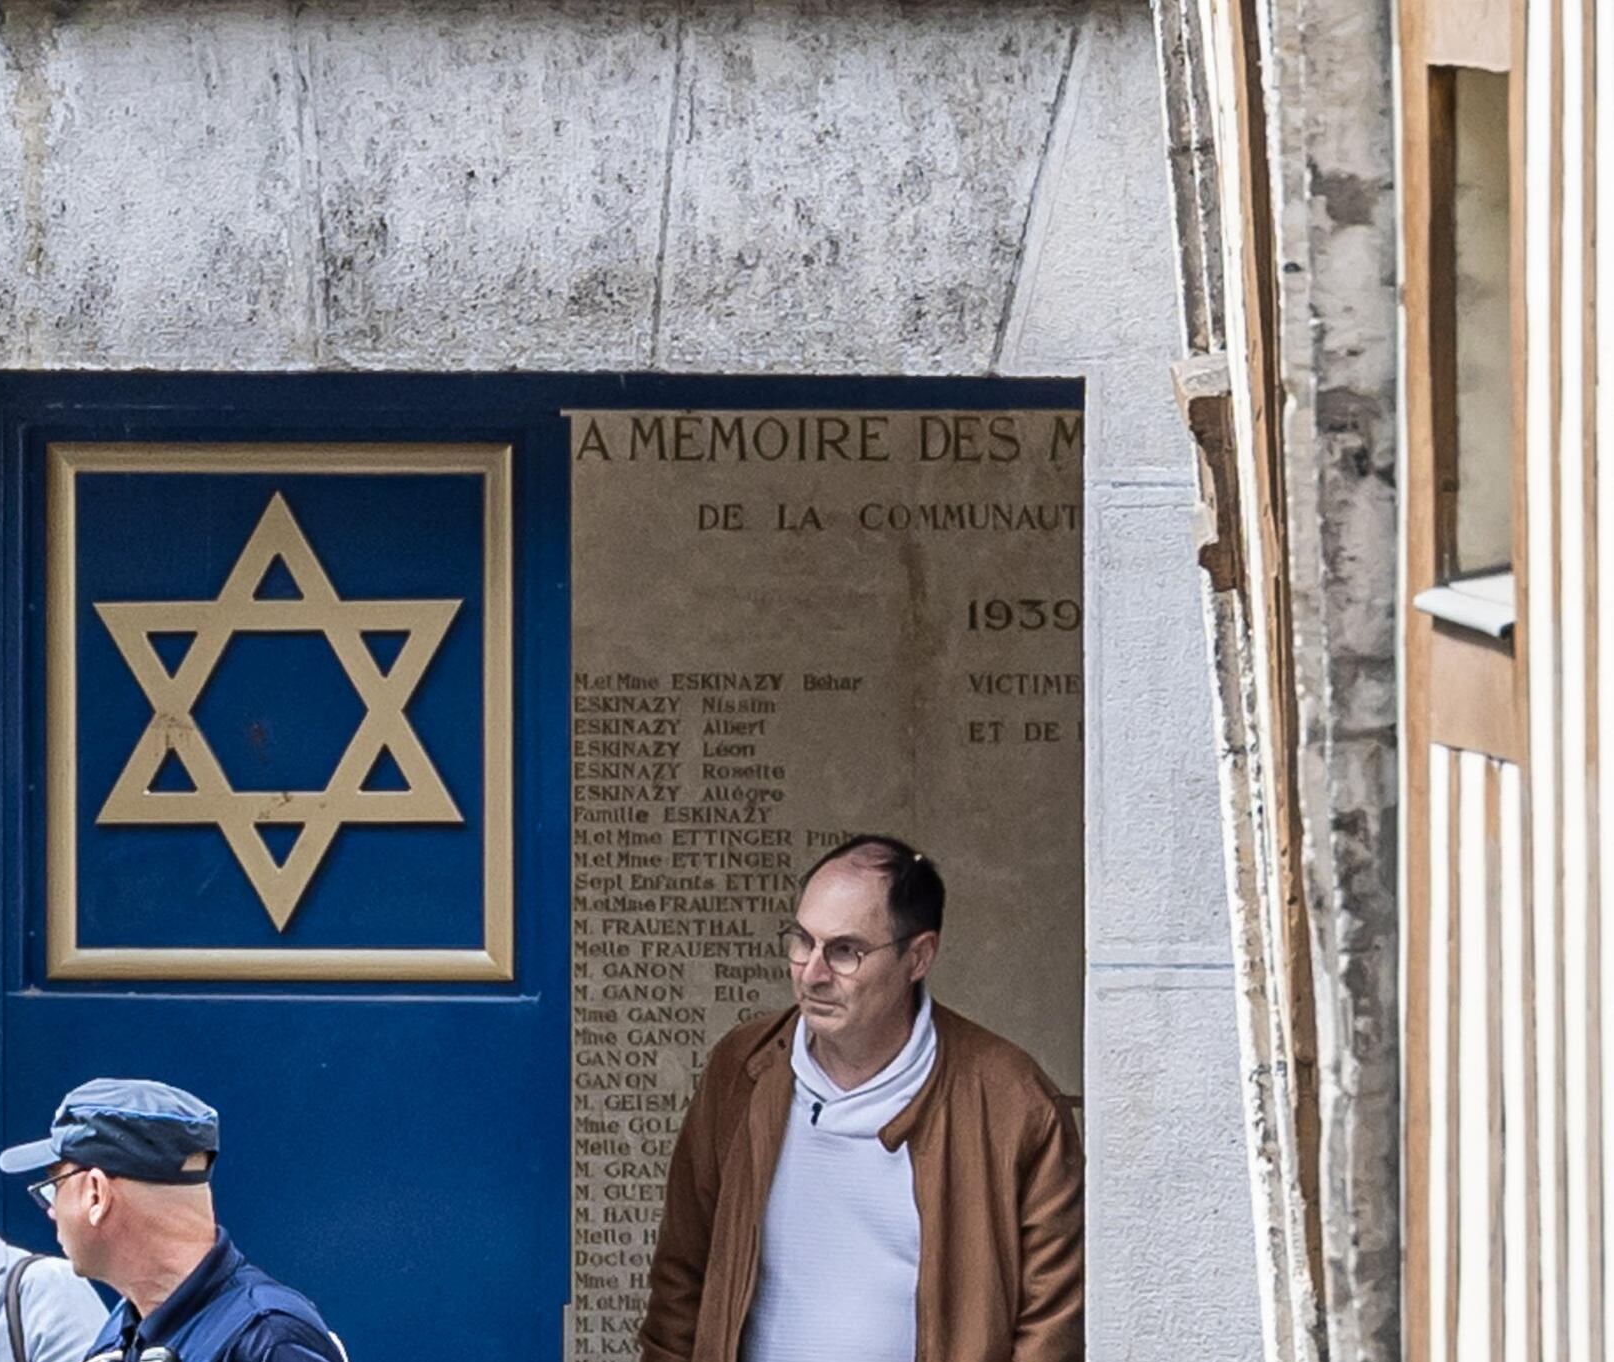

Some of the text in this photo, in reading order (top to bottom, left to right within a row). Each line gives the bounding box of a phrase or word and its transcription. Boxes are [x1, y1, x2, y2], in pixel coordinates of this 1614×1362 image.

[919, 415, 1021, 463] DES
[698, 503, 744, 531] DE
[777, 503, 825, 531] LA
[968, 599, 1082, 632] 1939
[671, 671, 784, 691] ESKINAZY
[574, 696, 777, 714] ESKINAZY Nissim
[574, 719, 766, 736] ESKINAZY Albert
[968, 720, 1005, 743] ET
[1024, 720, 1061, 743] DE
[574, 741, 680, 758] ESKINAZY
[574, 762, 681, 782] ESKINAZY
[574, 785, 680, 803] ESKINAZY
[574, 806, 771, 824] Famille ESKINAZY
[617, 829, 662, 846] Mme
[671, 829, 793, 846] ETTINGER
[617, 851, 662, 869] Mme
[671, 851, 792, 869] ETTINGER
[574, 873, 622, 893] Sept
[630, 873, 715, 891] Enfants
[602, 919, 755, 936] FRAUENTHAL
[574, 941, 630, 958] Melle
[603, 963, 685, 979] GANON
[602, 985, 684, 1002] GANON
[574, 1007, 706, 1024] Mme GANON
[574, 1028, 706, 1045] Mme GANON
[575, 1050, 658, 1067] GANON
[575, 1072, 658, 1090] GANON
[575, 1116, 620, 1134] Mme
[575, 1139, 631, 1156] Melle
[575, 1228, 632, 1245] Melle
[574, 1272, 619, 1289] Mme
